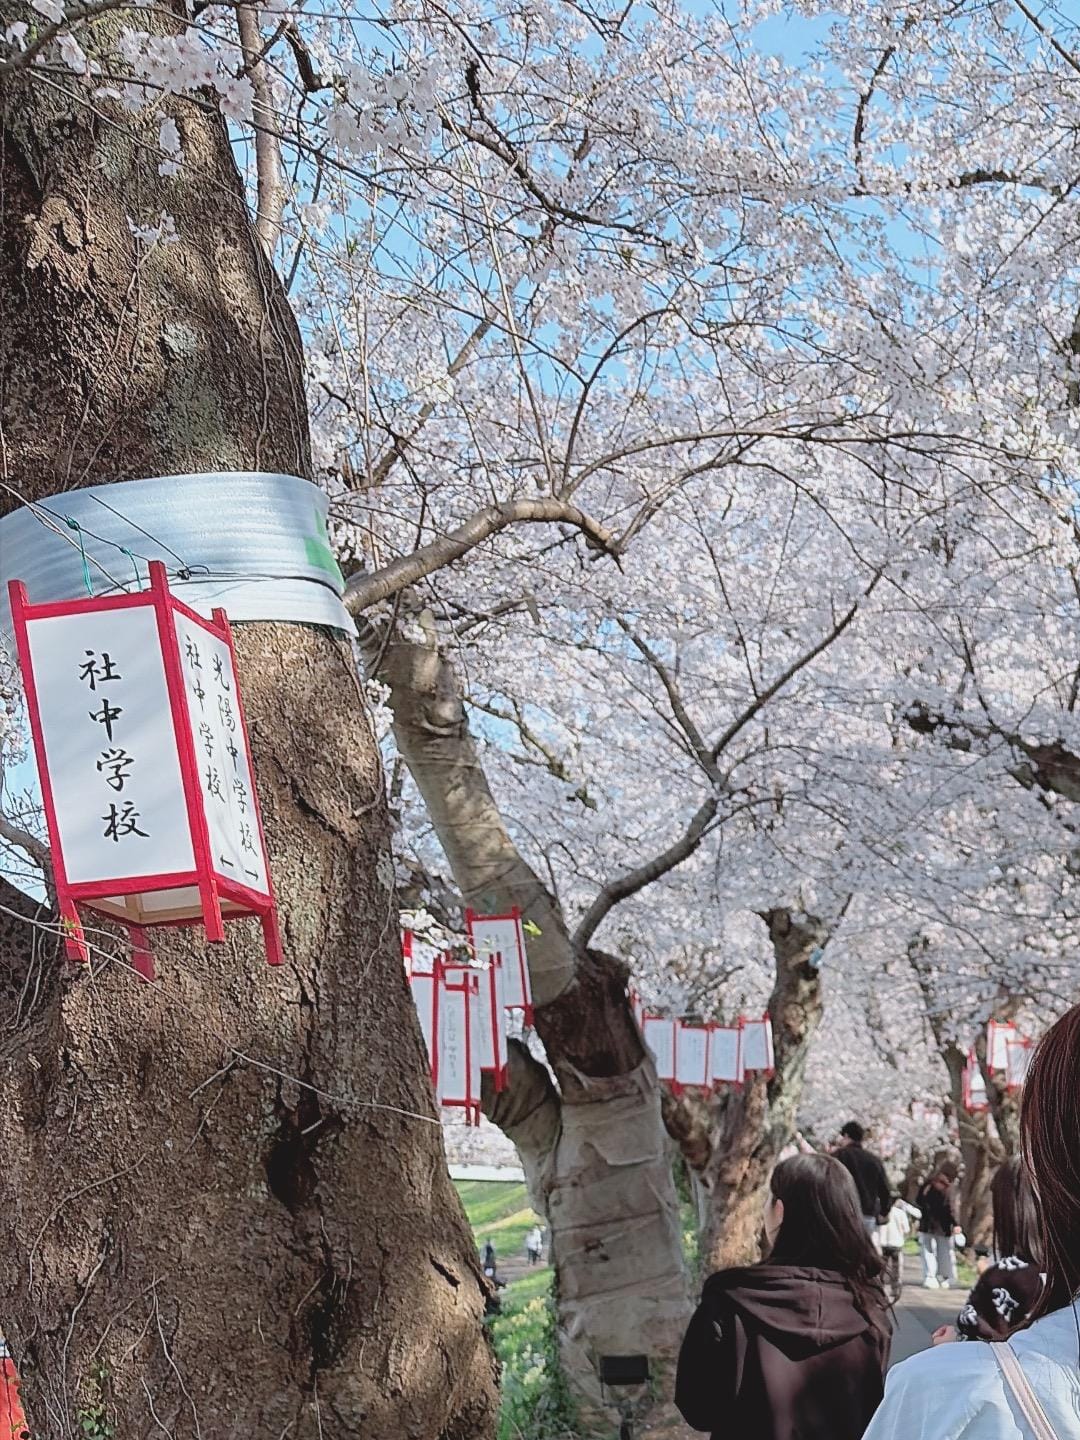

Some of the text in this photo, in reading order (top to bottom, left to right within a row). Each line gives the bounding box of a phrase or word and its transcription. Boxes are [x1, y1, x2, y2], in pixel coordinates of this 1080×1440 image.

[78, 649, 151, 843] 社中学校
[185, 634, 225, 804] 社中学校
